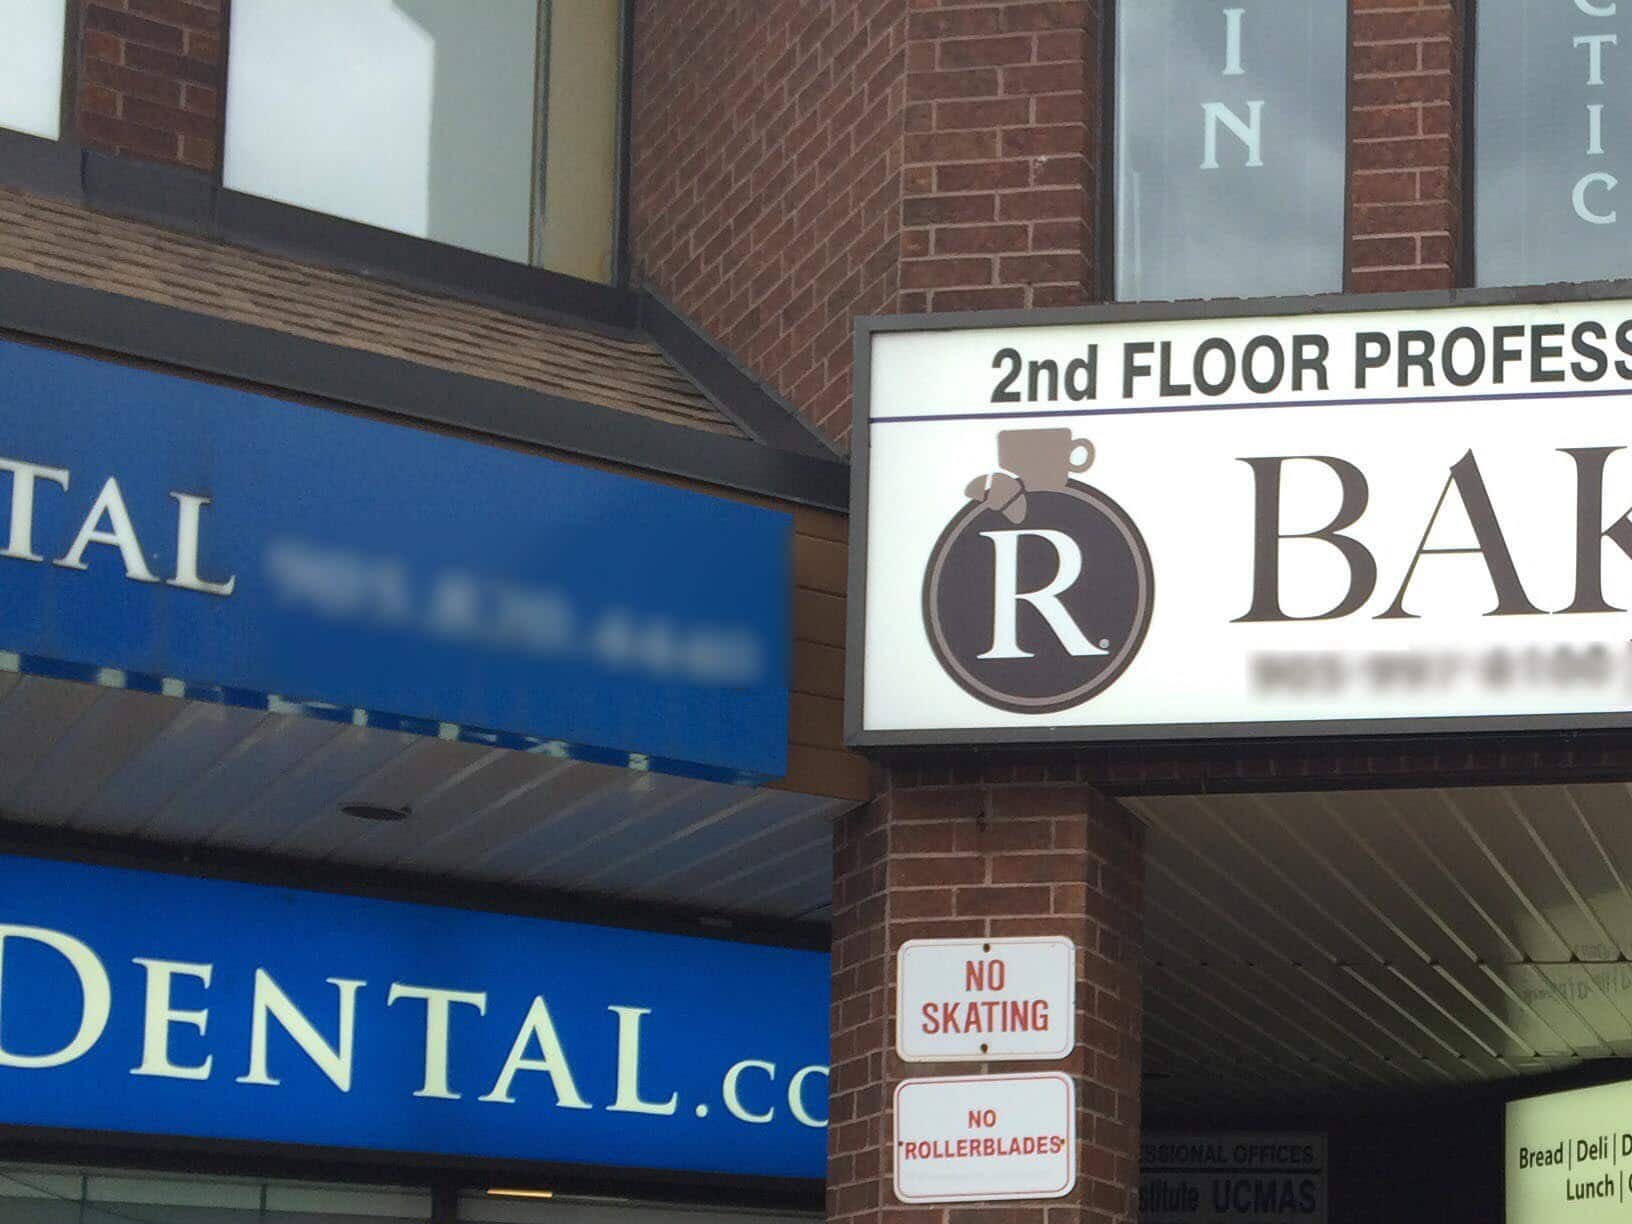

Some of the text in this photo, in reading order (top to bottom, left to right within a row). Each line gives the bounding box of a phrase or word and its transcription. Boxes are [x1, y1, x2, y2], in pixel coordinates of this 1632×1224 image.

[990, 344, 1098, 403] 2nd
[1122, 334, 1329, 399] FLOOR
[977, 530, 1110, 659] R
[965, 959, 1005, 991] NO
[922, 999, 1049, 1034] SKATING
[968, 1109, 997, 1129] NO
[905, 1136, 1062, 1160] ROLLERBLADES
[1520, 1141, 1564, 1169] Bread
[1576, 1136, 1609, 1162] Deli
[1213, 1179, 1316, 1214] UCMAS
[1566, 1174, 1614, 1200] Lunch
